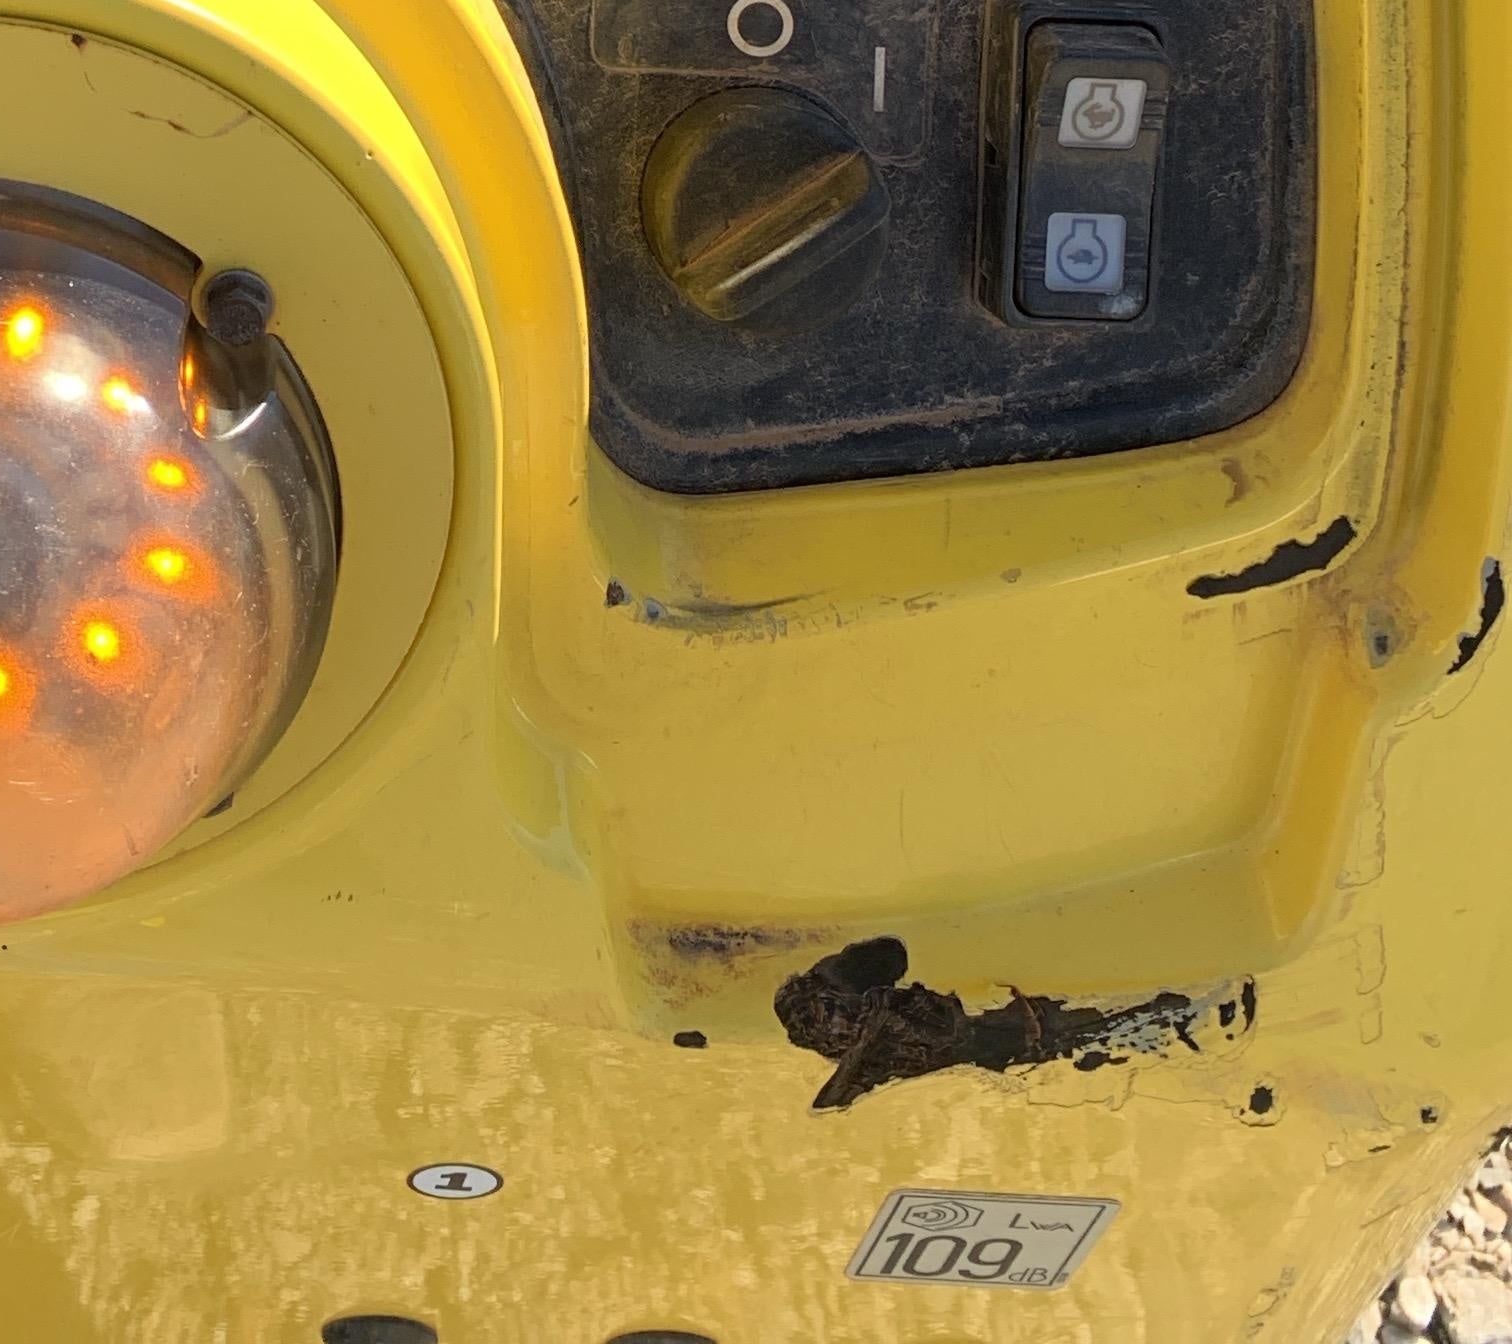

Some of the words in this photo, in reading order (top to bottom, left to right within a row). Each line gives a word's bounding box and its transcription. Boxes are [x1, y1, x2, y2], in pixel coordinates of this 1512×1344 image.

[435, 1171, 473, 1193] 1
[880, 1232, 1023, 1280] 109
[1008, 1268, 1047, 1282] dB
